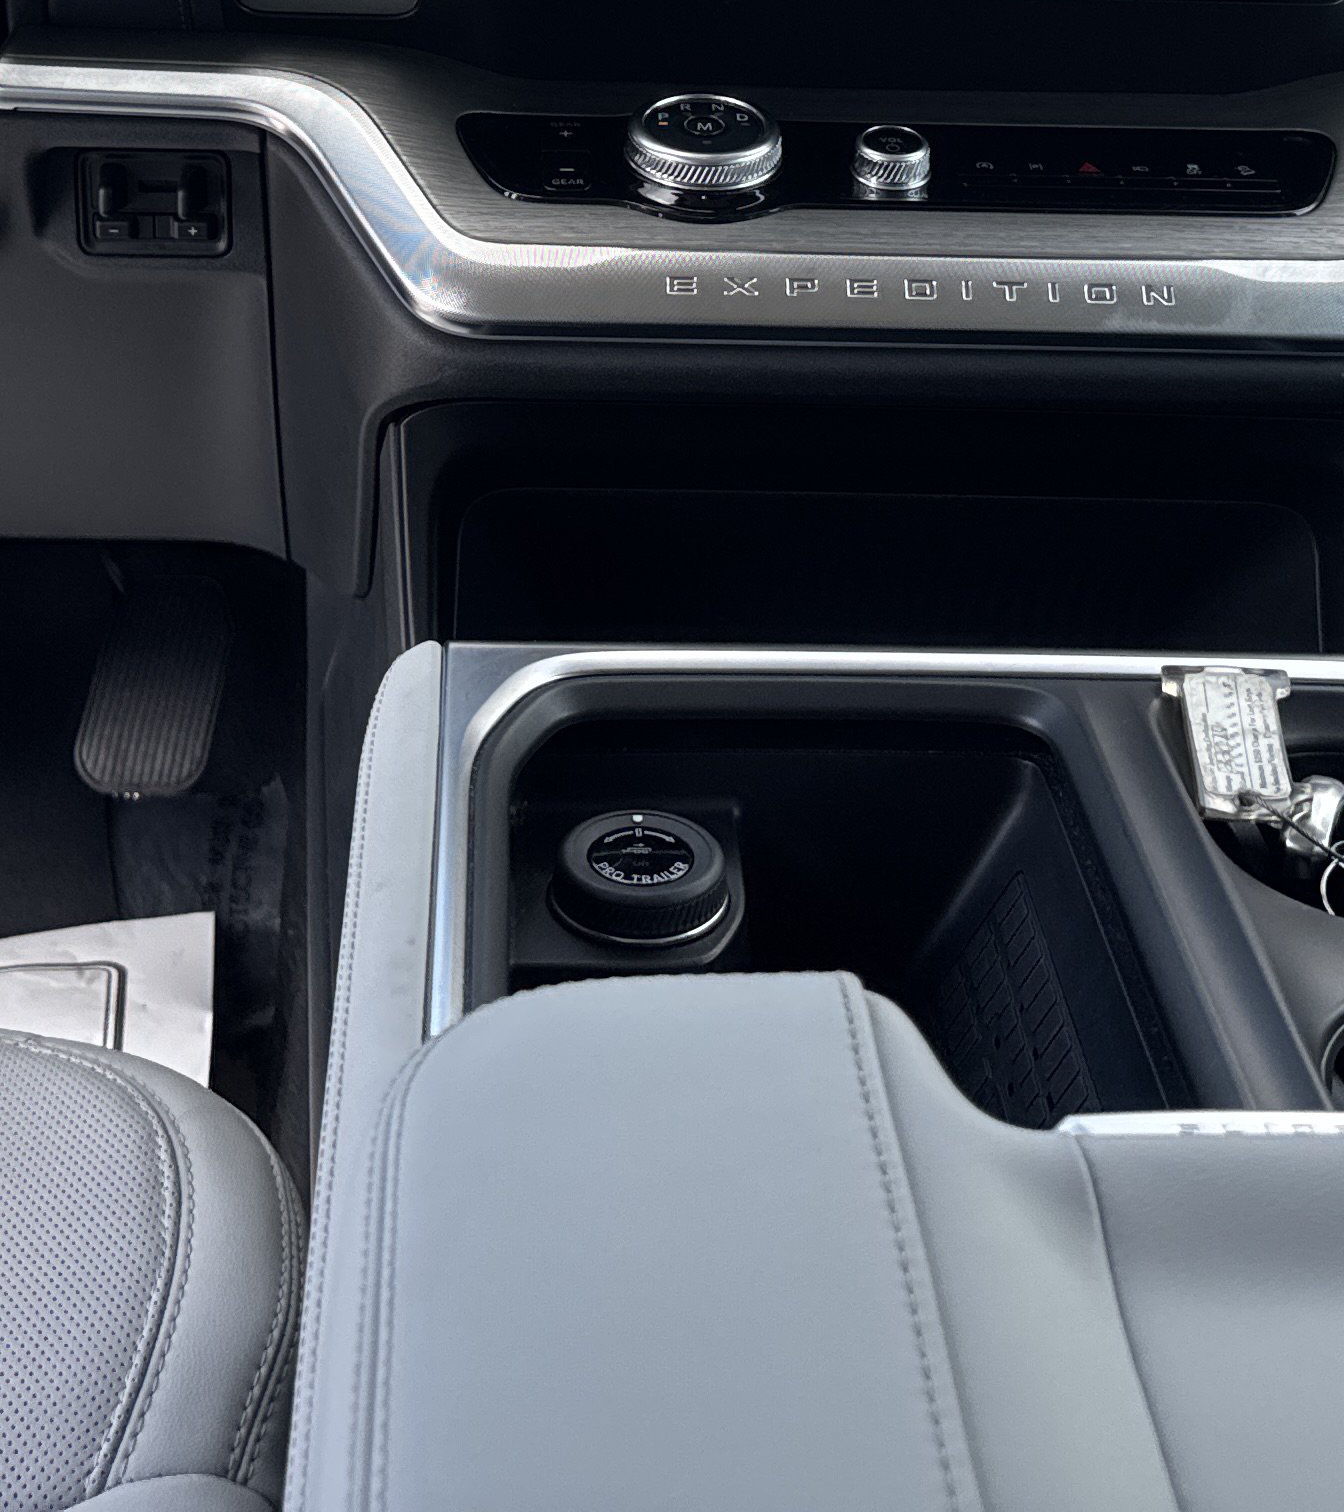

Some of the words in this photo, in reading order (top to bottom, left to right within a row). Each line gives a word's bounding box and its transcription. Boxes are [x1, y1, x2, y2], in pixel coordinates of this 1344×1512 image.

[680, 103, 692, 111] R
[712, 103, 724, 111] N
[658, 112, 669, 121] P
[736, 113, 749, 122] D
[697, 122, 713, 131] M
[665, 274, 1176, 307] EXPEDITION
[597, 861, 624, 881] PRO
[632, 861, 689, 884] TRAILER
